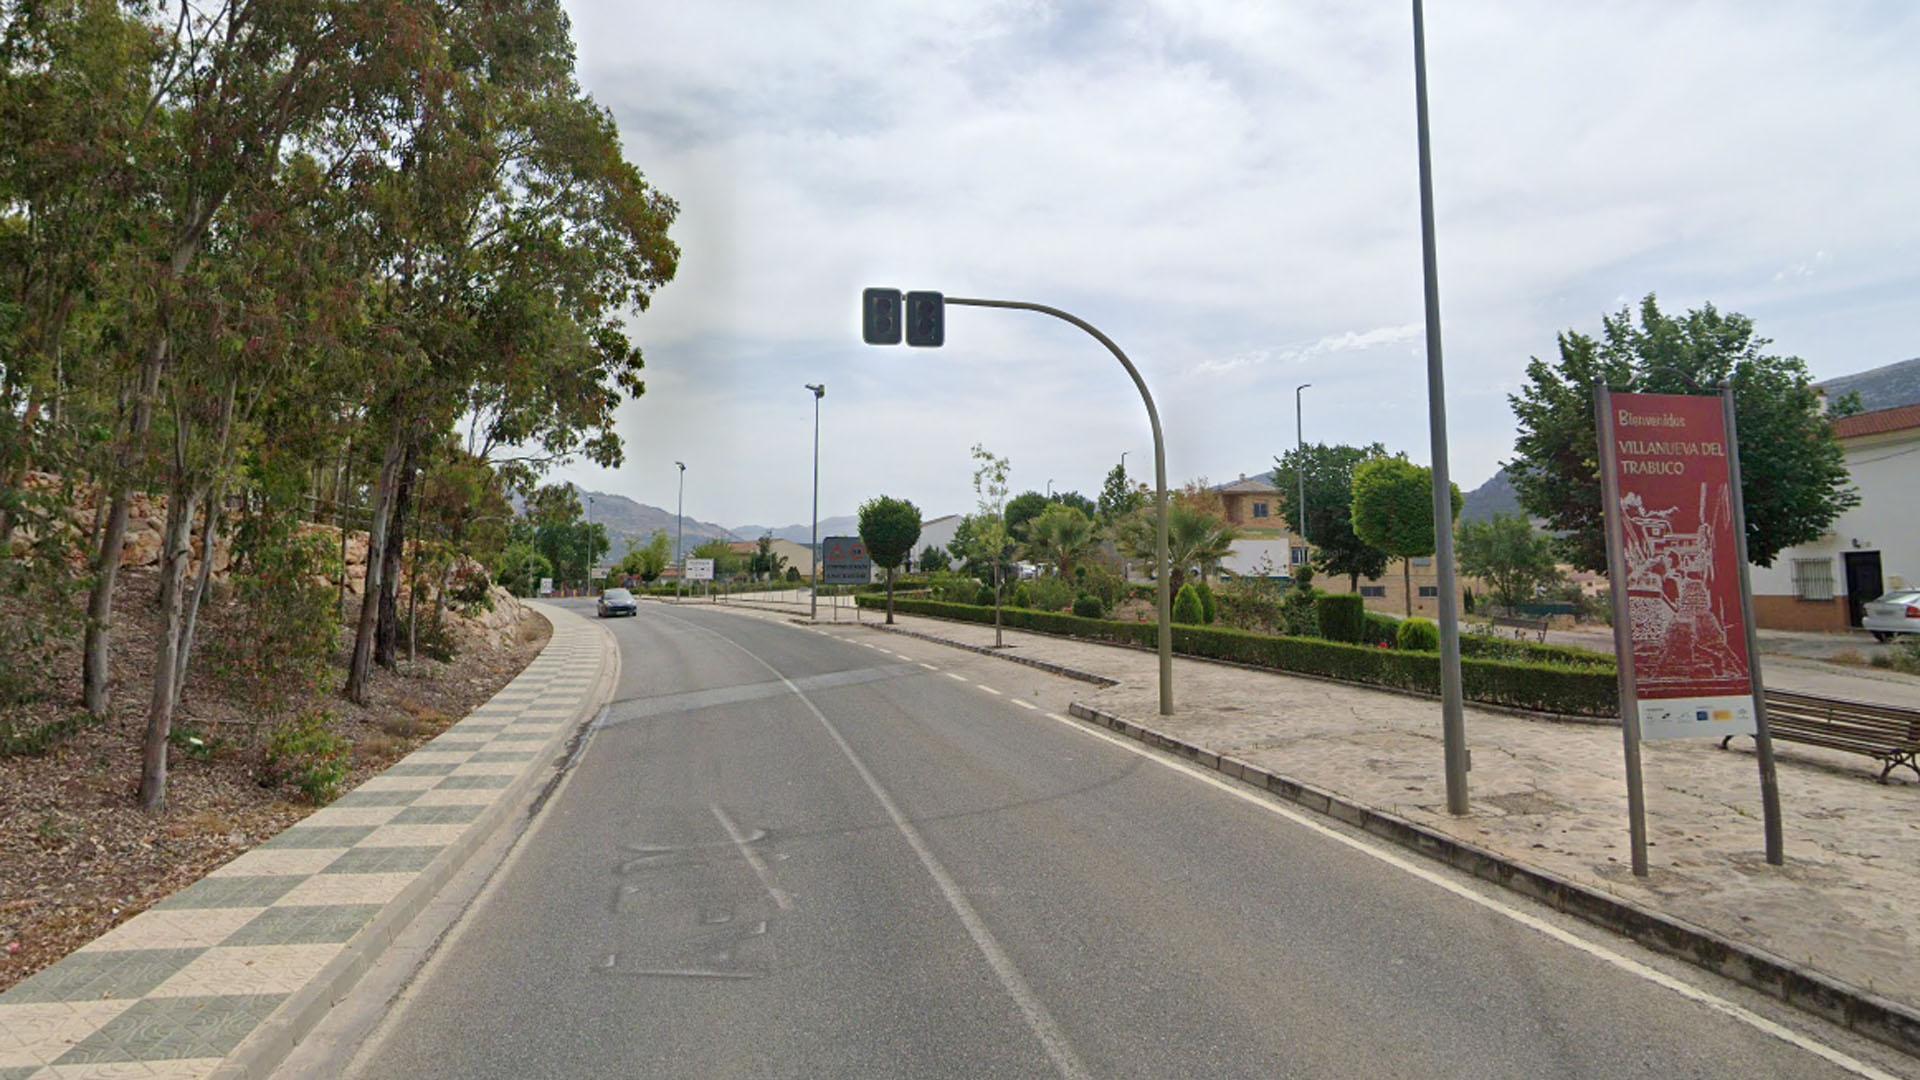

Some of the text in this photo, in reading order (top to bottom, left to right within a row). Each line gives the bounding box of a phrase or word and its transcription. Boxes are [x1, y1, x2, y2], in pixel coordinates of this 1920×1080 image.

[1618, 409, 1686, 428] Bienvenidos
[1618, 440, 1725, 457] VILLANUEVA DEL
[1620, 459, 1685, 475] TRABUCO
